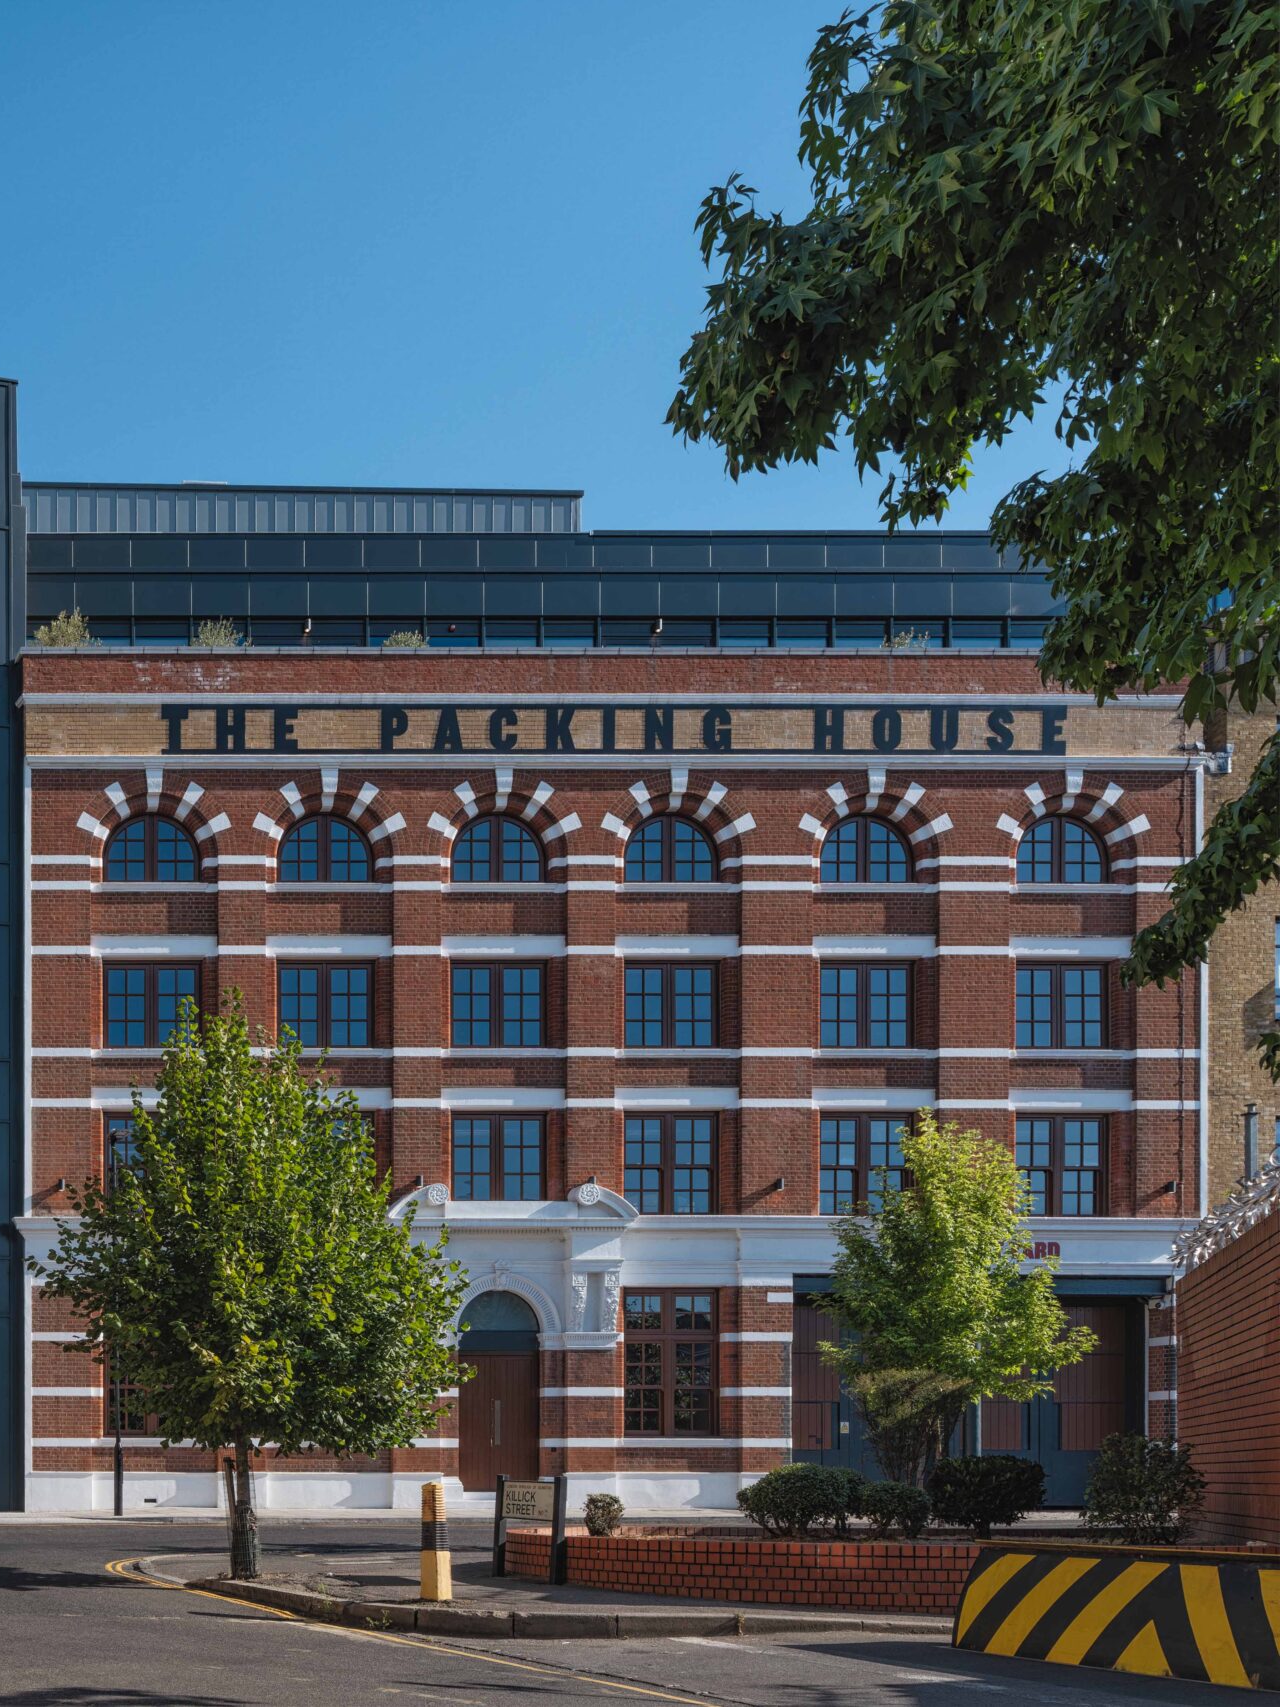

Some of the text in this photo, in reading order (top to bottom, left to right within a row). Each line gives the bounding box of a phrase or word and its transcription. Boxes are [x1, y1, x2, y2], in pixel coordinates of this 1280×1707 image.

[161, 703, 1068, 755] THE PACKING HOUSE
[1008, 1241, 1061, 1260] ARD
[505, 1490, 537, 1503] KILLICK
[505, 1503, 537, 1516] STREET
